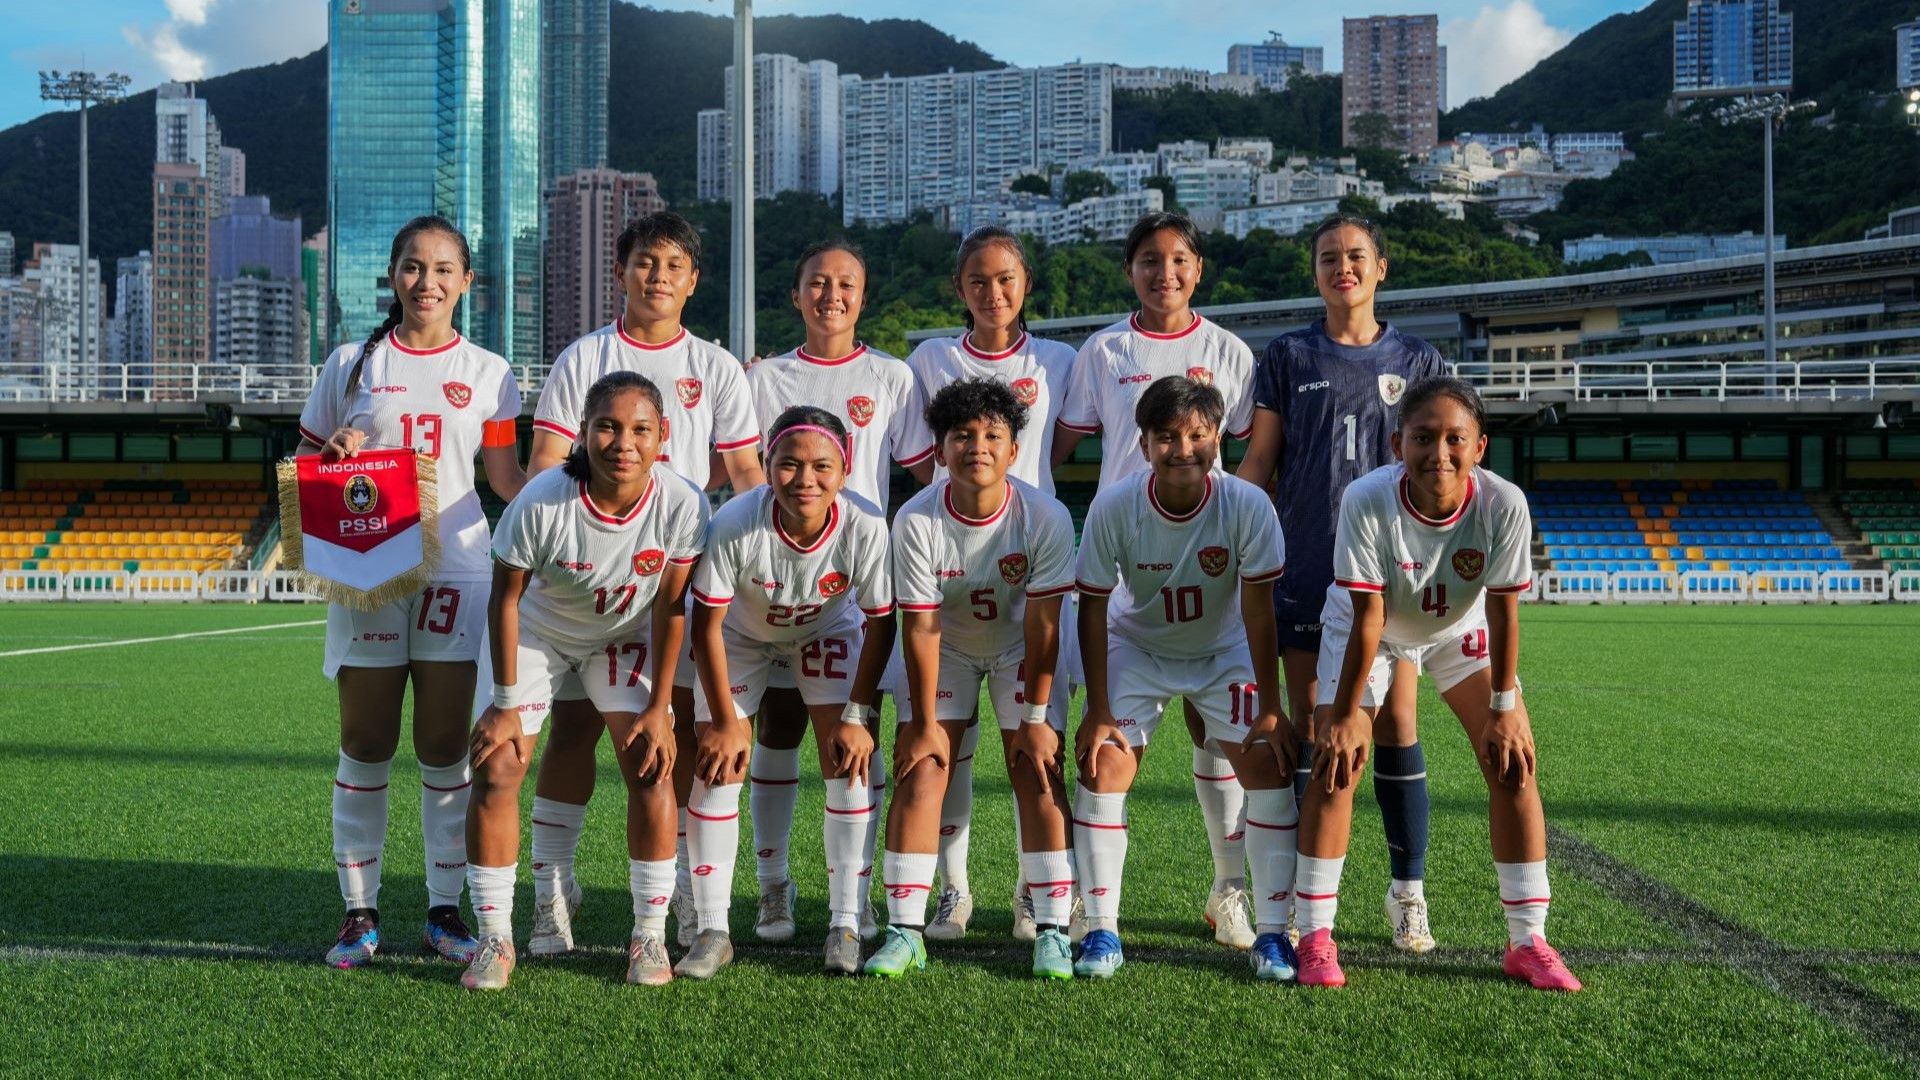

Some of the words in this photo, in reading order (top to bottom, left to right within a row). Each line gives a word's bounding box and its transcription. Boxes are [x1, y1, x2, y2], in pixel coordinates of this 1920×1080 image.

[371, 384, 407, 394] erspo
[1119, 373, 1151, 385] erspo
[1298, 380, 1330, 393] erspo
[400, 413, 442, 461] 13
[1343, 415, 1357, 460] 1
[318, 459, 399, 475] INDONESIA
[339, 516, 388, 534] PSSI
[1136, 562, 1173, 572] erspo
[417, 586, 462, 636] 13
[594, 583, 638, 615] 17
[970, 588, 998, 621] 5
[1160, 584, 1204, 625] 10
[1421, 584, 1450, 618] 4
[765, 603, 823, 628] 22
[362, 631, 400, 644] erspo
[1460, 629, 1489, 660] 4
[606, 642, 648, 688] 17
[800, 637, 849, 680] 22
